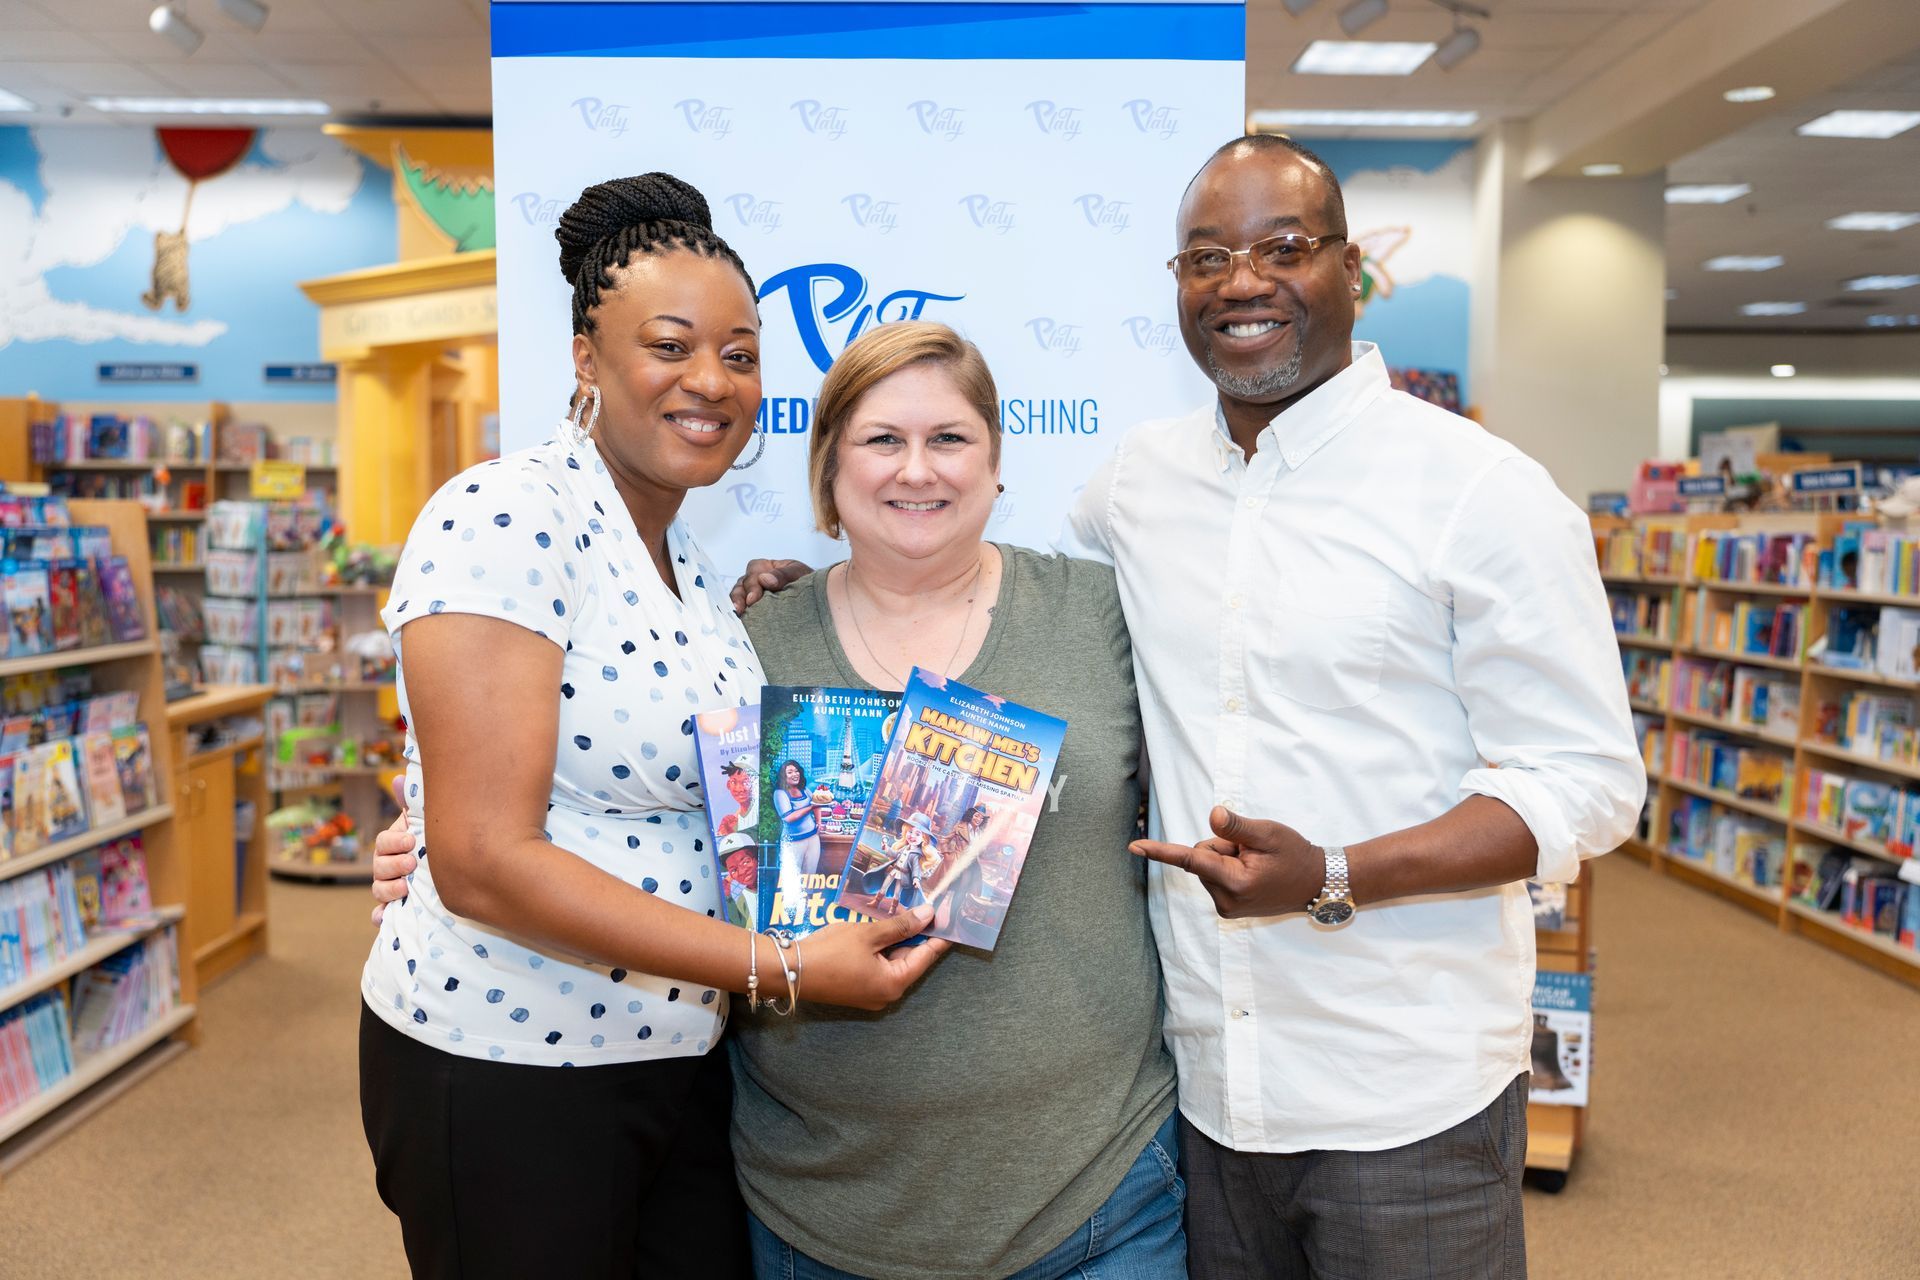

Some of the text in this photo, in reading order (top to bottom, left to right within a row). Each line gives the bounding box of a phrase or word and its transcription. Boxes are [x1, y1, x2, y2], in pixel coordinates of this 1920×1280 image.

[792, 694, 851, 705] ELIZABETH
[813, 706, 883, 718] AUNTIE NANN
[950, 696, 1026, 730] ELIZABETH JOHNSON
[960, 710, 1010, 733] AUNTIE NANN
[719, 725, 749, 746] Just
[919, 706, 1041, 763] MAMAW MEL'S
[720, 749, 729, 757] By
[904, 721, 1040, 794] KITCHEN
[942, 769, 956, 778] CASE
[976, 781, 1000, 793] MISSING
